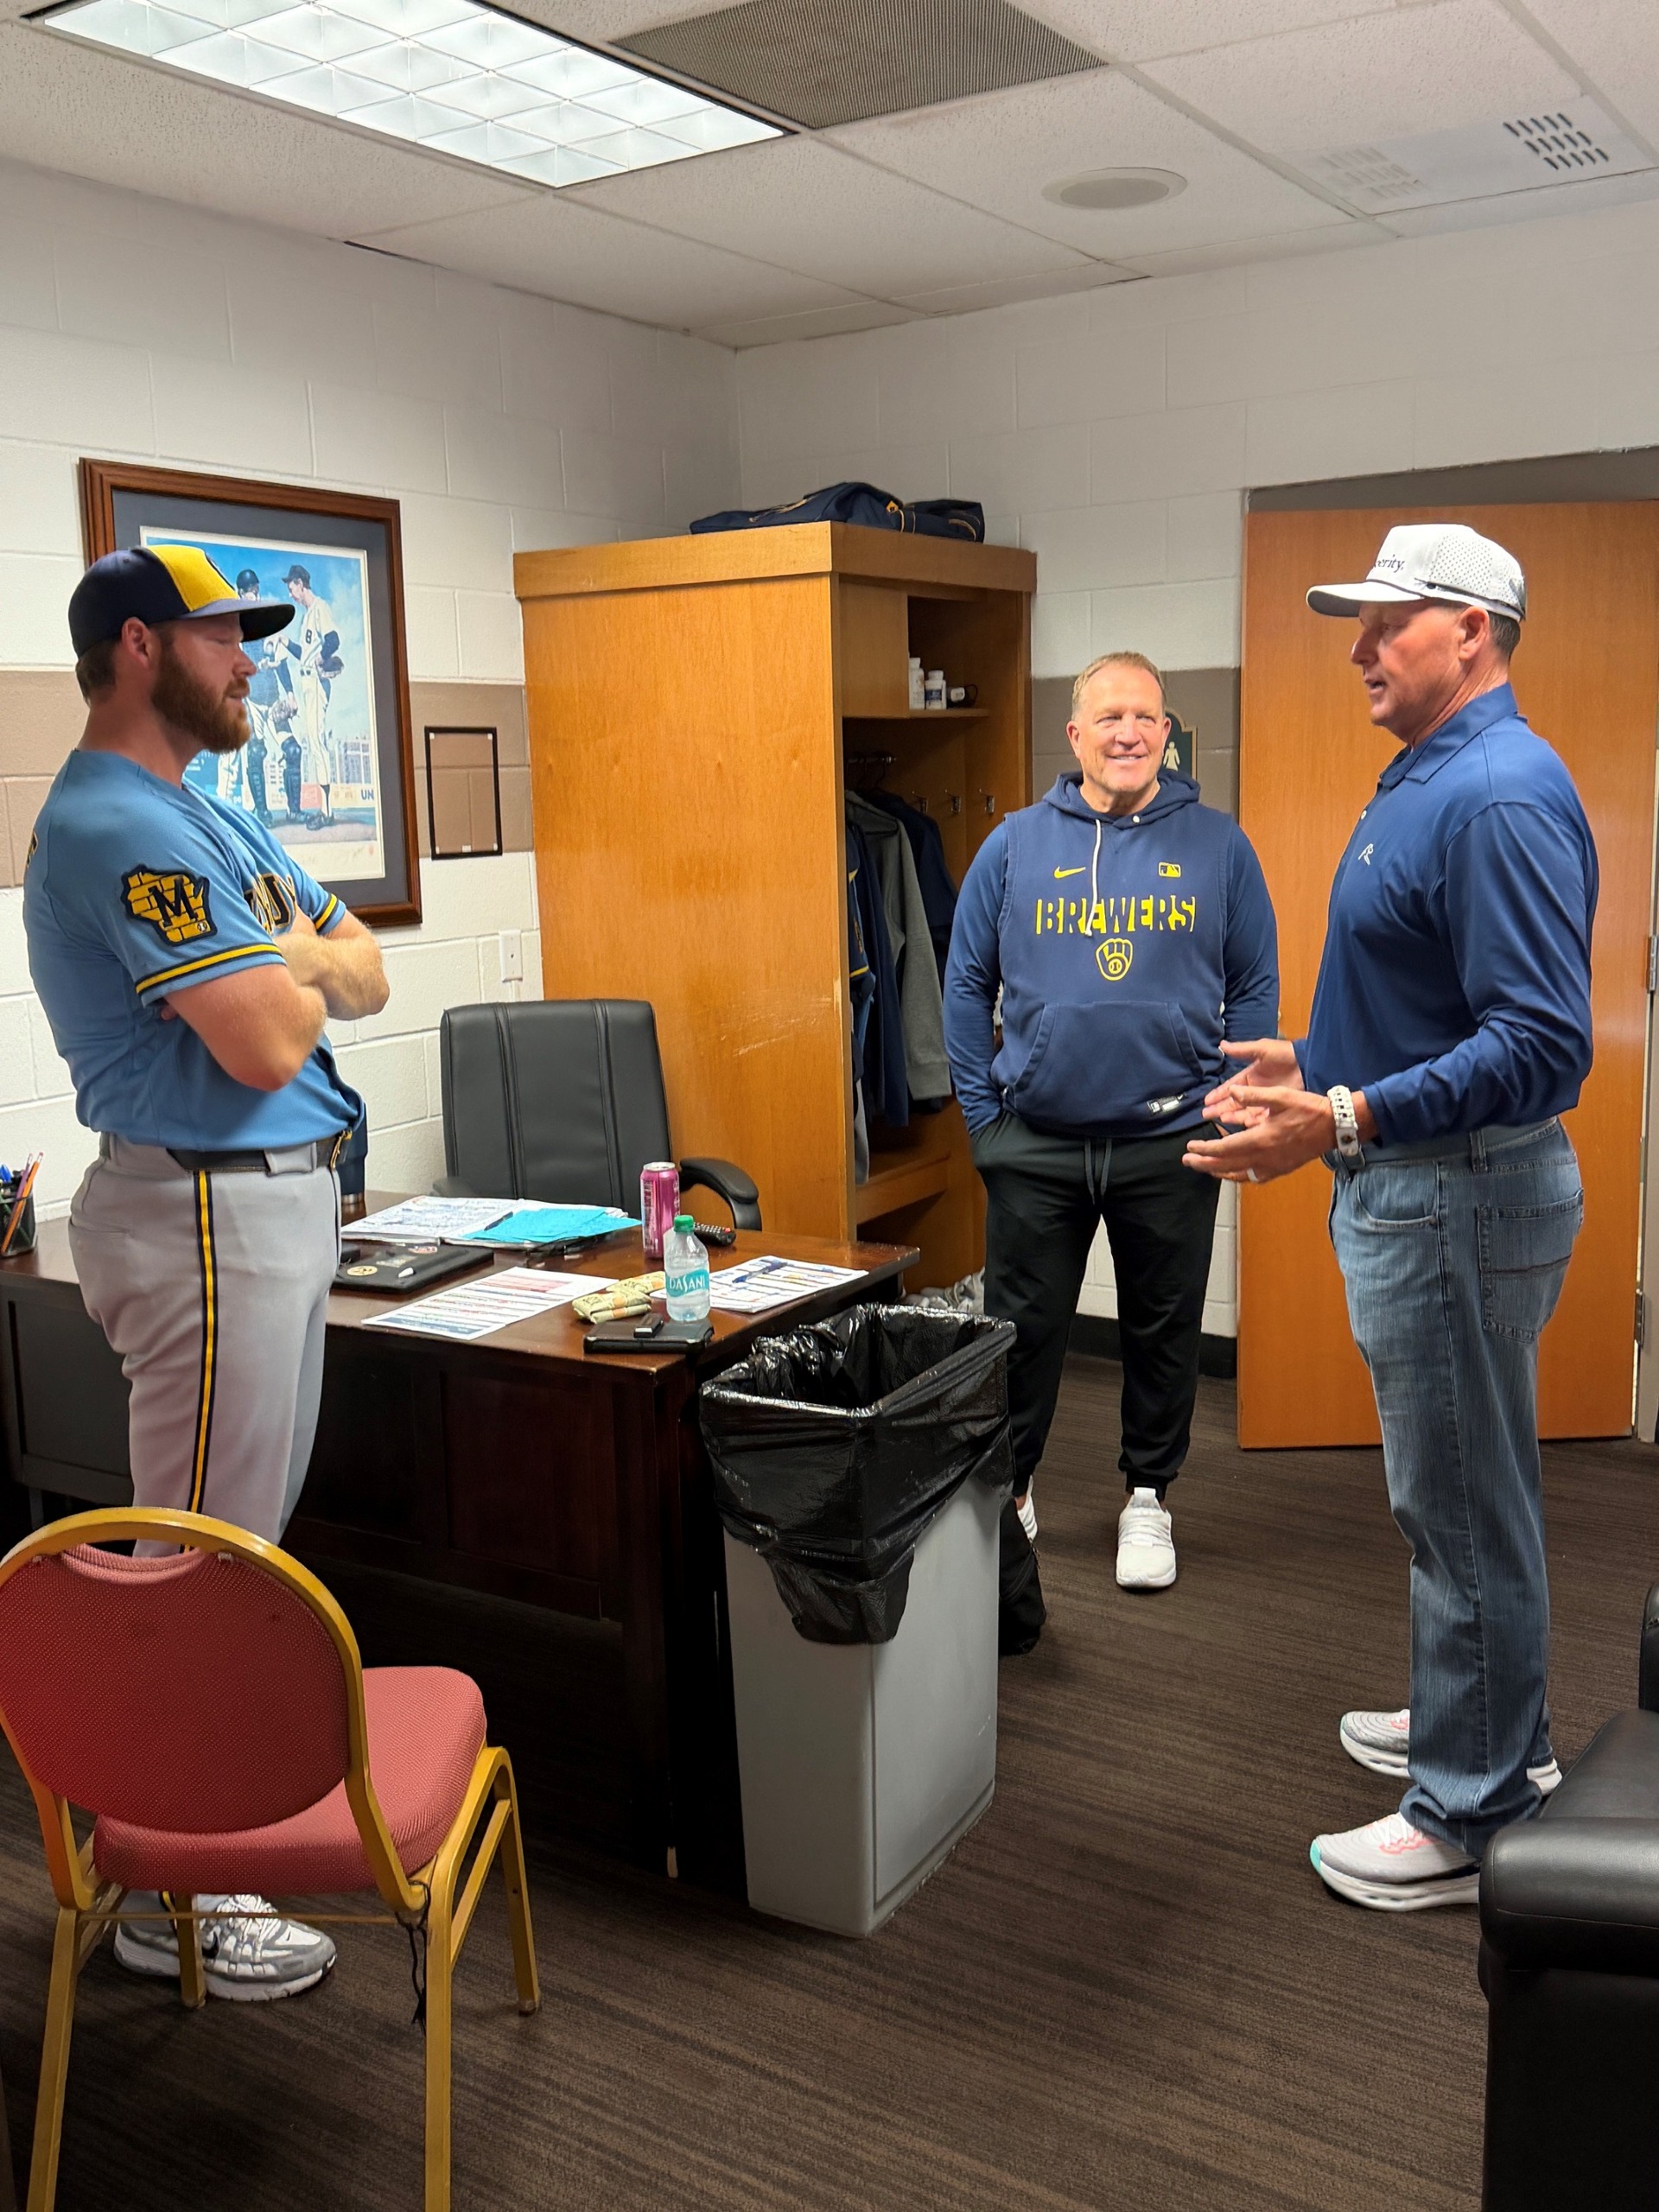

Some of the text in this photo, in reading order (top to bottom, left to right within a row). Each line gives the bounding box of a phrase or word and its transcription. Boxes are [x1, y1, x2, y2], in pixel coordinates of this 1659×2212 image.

[149, 877, 198, 928] M
[1036, 894, 1196, 934] BREWERS
[669, 1274, 706, 1293] DASANI
